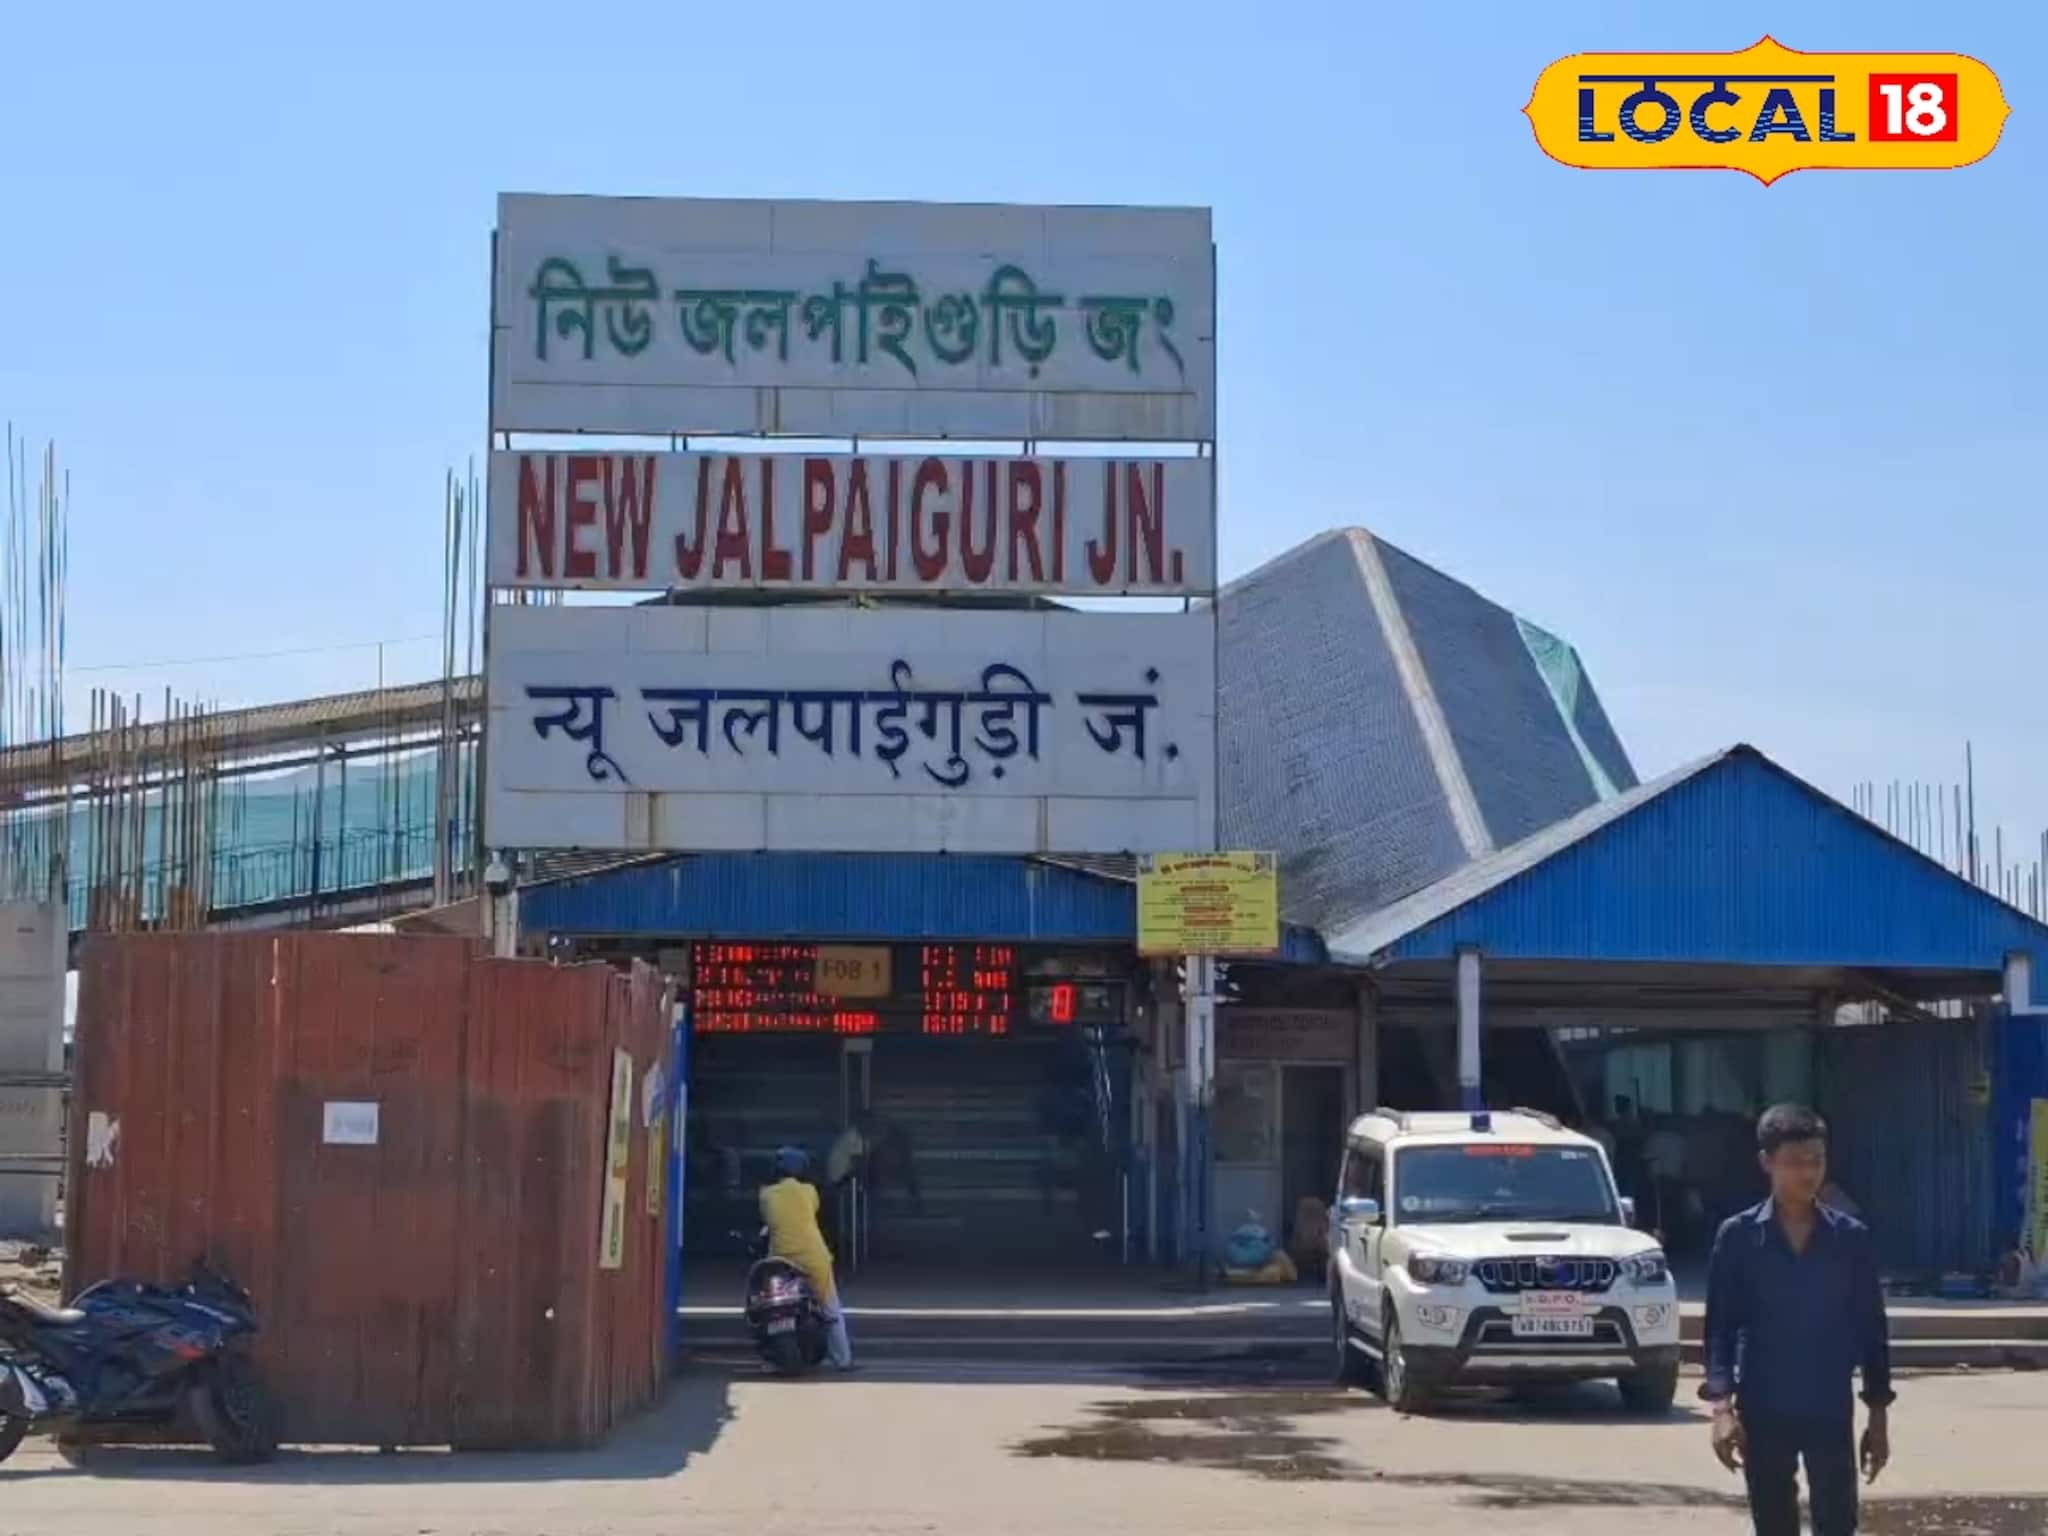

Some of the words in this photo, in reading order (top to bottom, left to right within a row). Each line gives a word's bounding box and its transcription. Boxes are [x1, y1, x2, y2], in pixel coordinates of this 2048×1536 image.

[527, 253, 659, 362] নিউ
[673, 258, 1065, 384] জলপাইগুড়ি
[1079, 296, 1185, 376] জং
[515, 456, 656, 579] NEW
[674, 455, 1065, 583] JALPAIGURI
[1085, 459, 1183, 583] JN.
[525, 685, 635, 785] न्यू
[640, 659, 1051, 787] जलपाईगुड़ी
[1076, 667, 1179, 761] जं.
